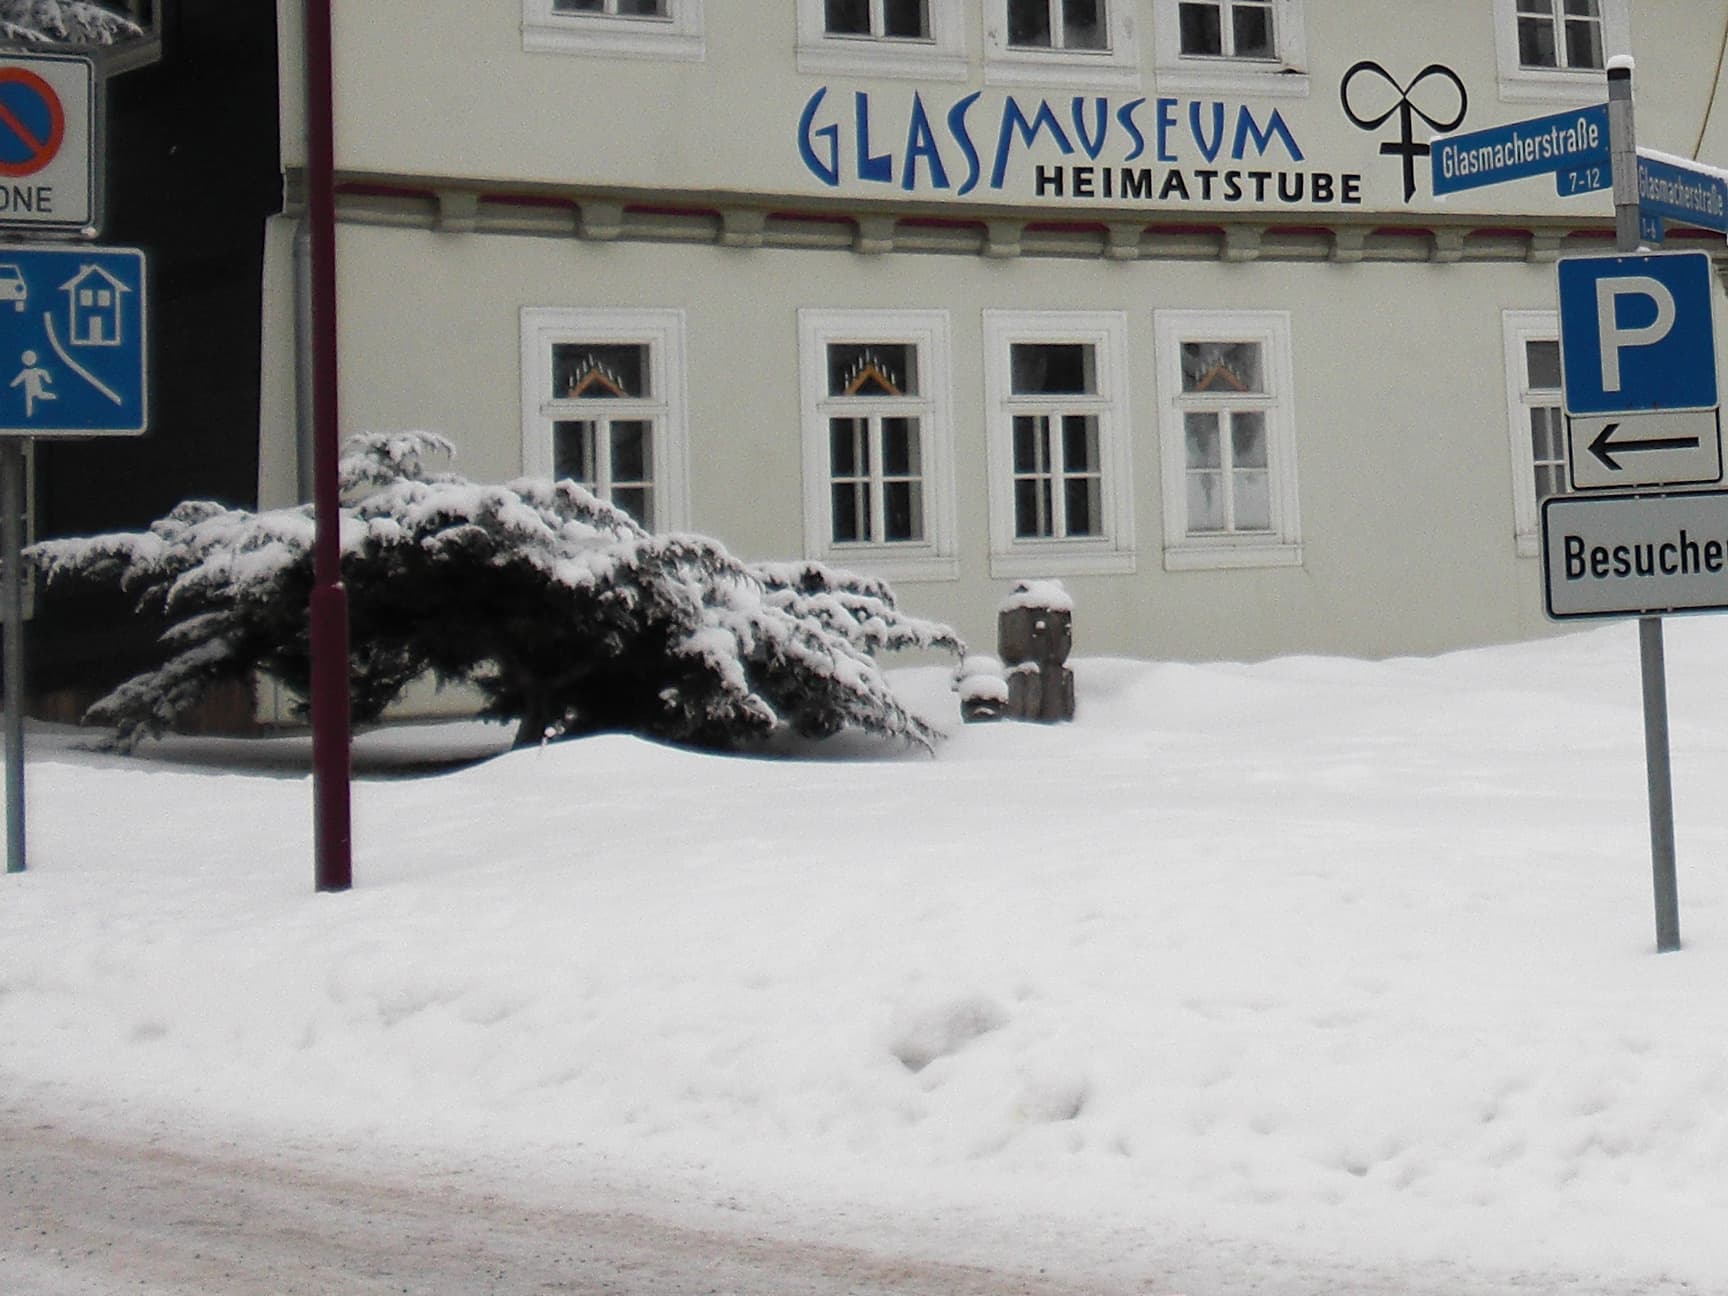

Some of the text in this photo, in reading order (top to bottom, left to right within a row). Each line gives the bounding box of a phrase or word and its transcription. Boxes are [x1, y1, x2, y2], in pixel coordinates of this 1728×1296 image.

[797, 85, 1304, 195] GLASMUSEUM
[1442, 116, 1599, 179] Glasmacherstraße
[1035, 165, 1362, 204] HEIMATSTUBE
[1568, 168, 1600, 193] 7-12
[1638, 163, 1723, 217] Glasmacherstraße
[1595, 276, 1676, 393] P
